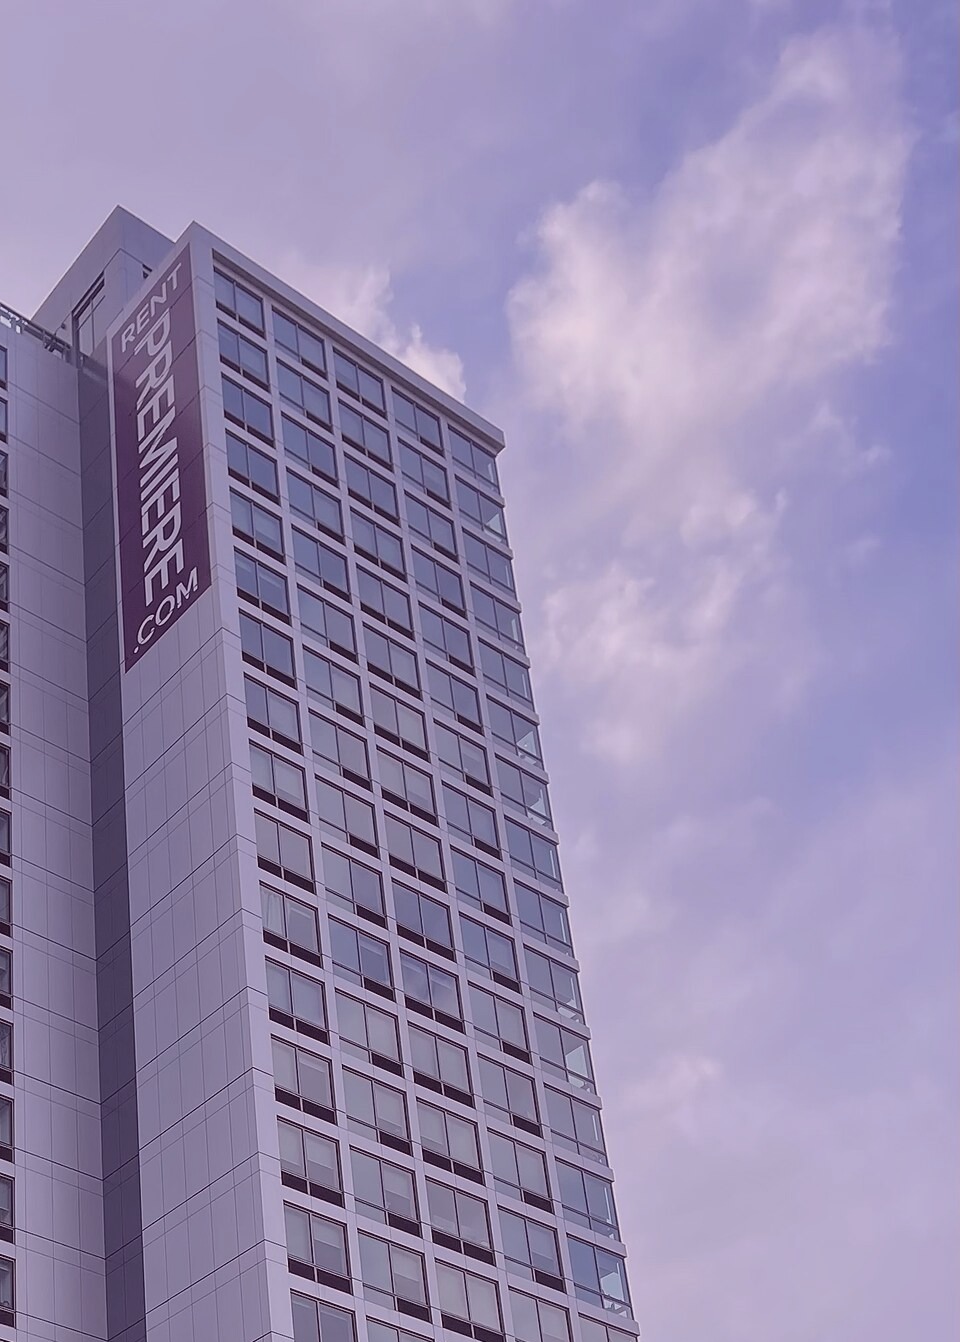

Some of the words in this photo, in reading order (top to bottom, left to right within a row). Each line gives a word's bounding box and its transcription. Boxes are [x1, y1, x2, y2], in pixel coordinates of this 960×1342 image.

[121, 262, 181, 353] RENT
[133, 308, 184, 607] PREMIERE
[133, 567, 198, 654] .COM
